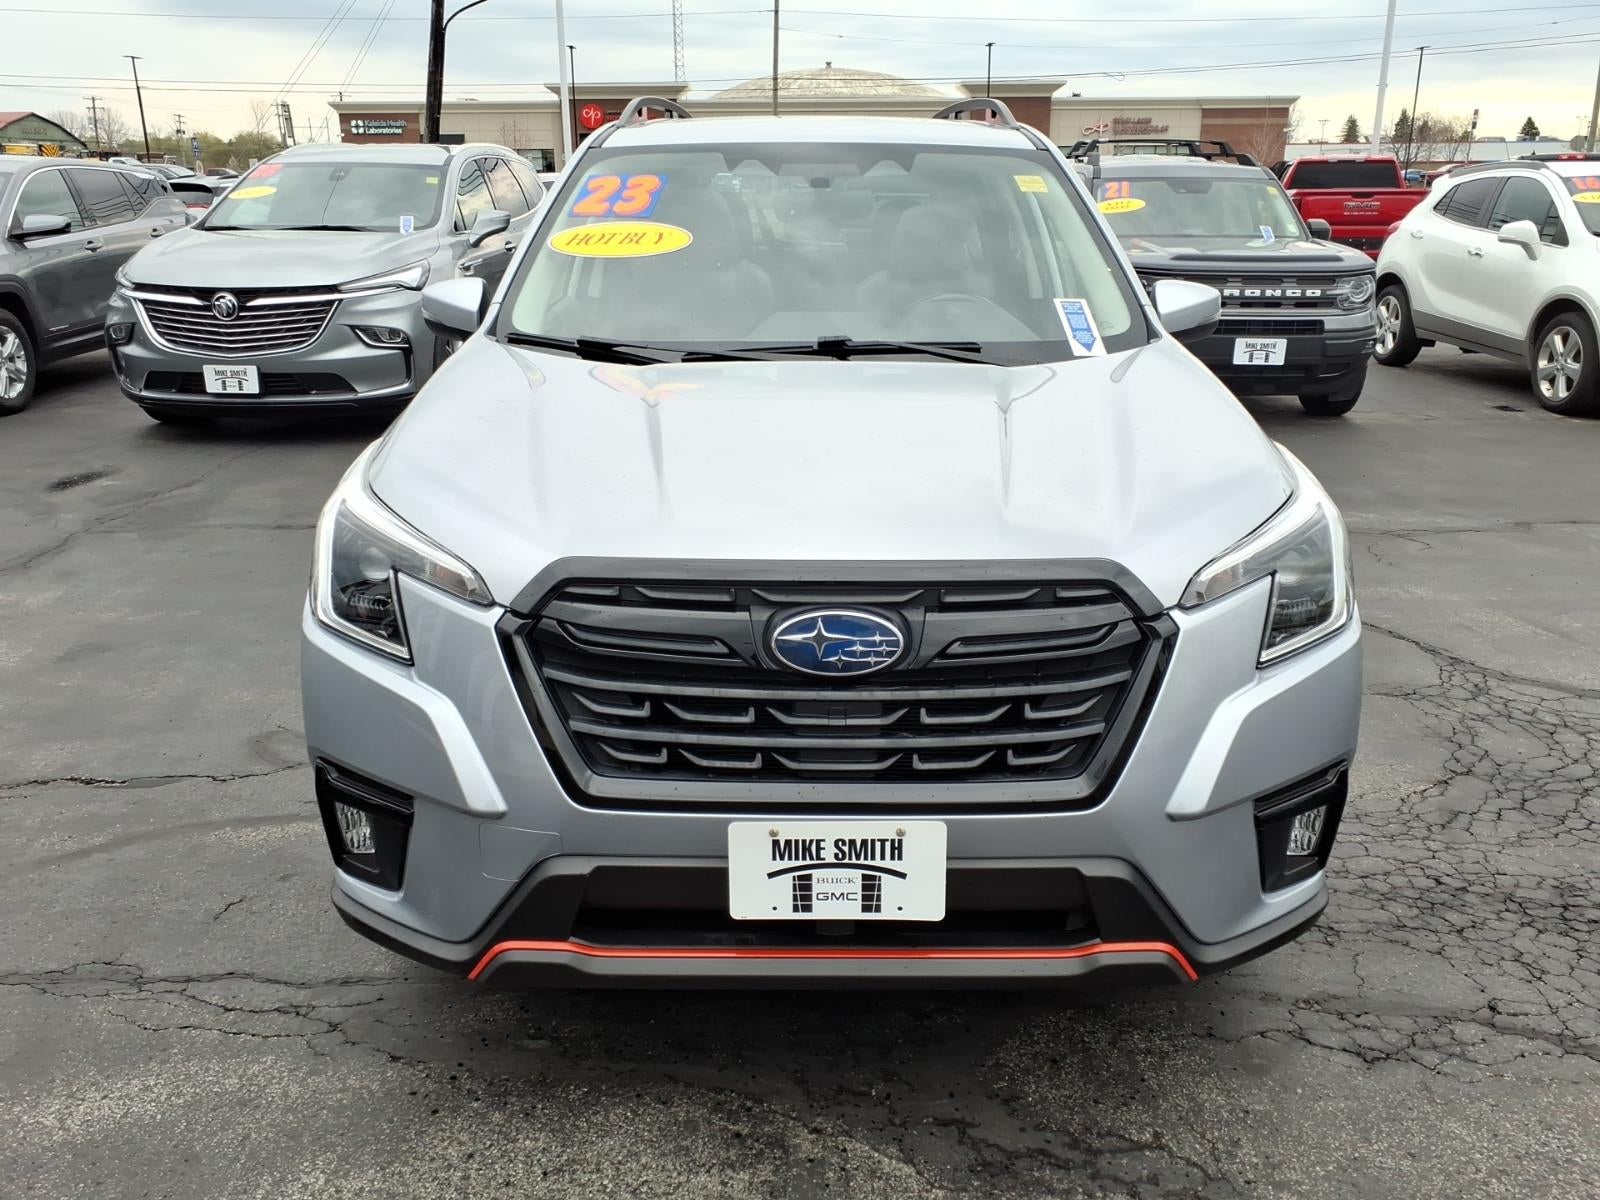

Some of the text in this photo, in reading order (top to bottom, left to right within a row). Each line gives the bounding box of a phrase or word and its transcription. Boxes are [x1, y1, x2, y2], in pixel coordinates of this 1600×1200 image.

[387, 119, 407, 127] Health
[1104, 180, 1132, 200] 21
[572, 174, 662, 216] 23
[1343, 201, 1381, 209] GMC
[1222, 289, 1322, 297] RONCO
[1244, 341, 1277, 350] MIKE SMITH
[214, 369, 248, 377] MIKE SMITH
[771, 838, 903, 861] MIKE SMITH
[816, 876, 857, 885] BUICK
[816, 892, 858, 901] GMC
